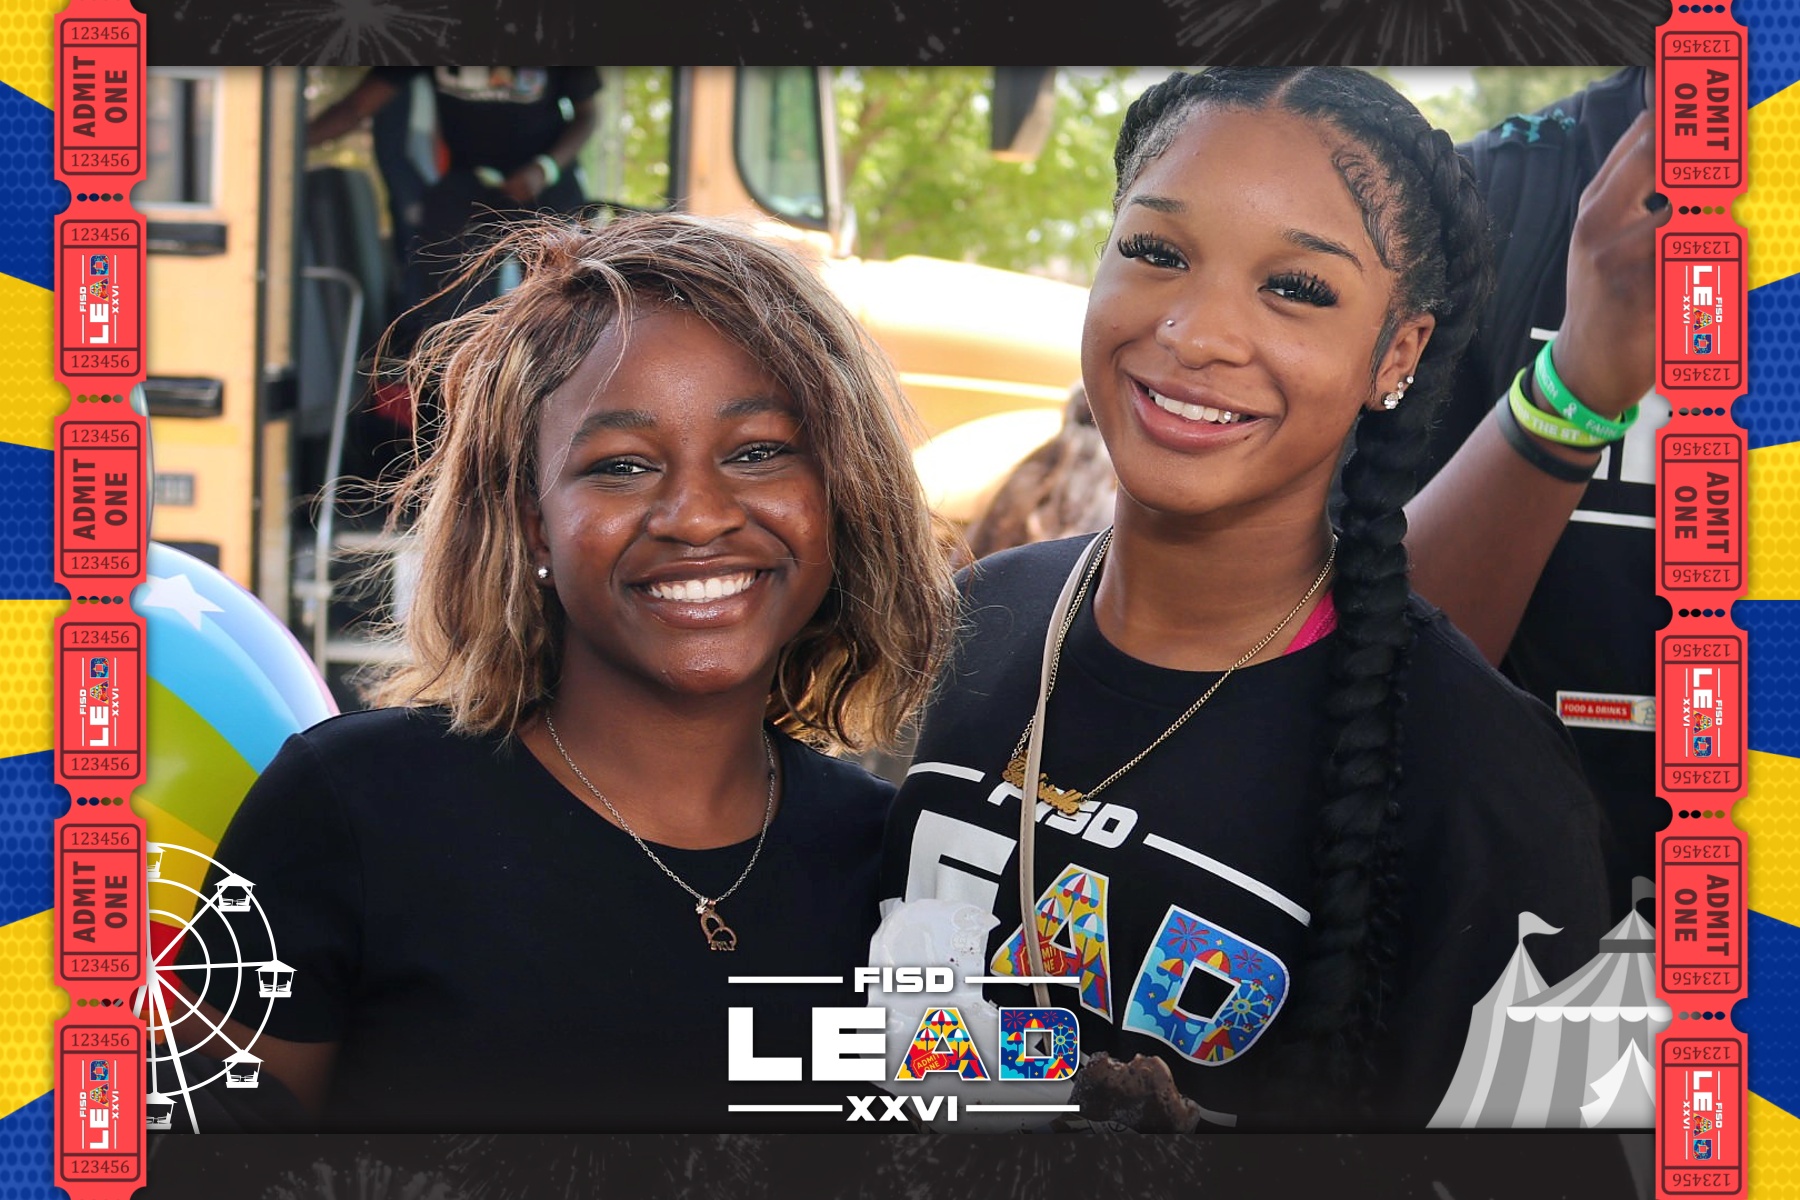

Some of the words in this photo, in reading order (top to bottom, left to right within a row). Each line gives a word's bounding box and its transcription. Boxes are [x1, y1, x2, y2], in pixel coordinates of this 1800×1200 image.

[1532, 418, 1559, 436] THE
[1564, 703, 1587, 713] FOOD
[1587, 704, 1594, 714] &
[1595, 705, 1628, 716] DRINKS
